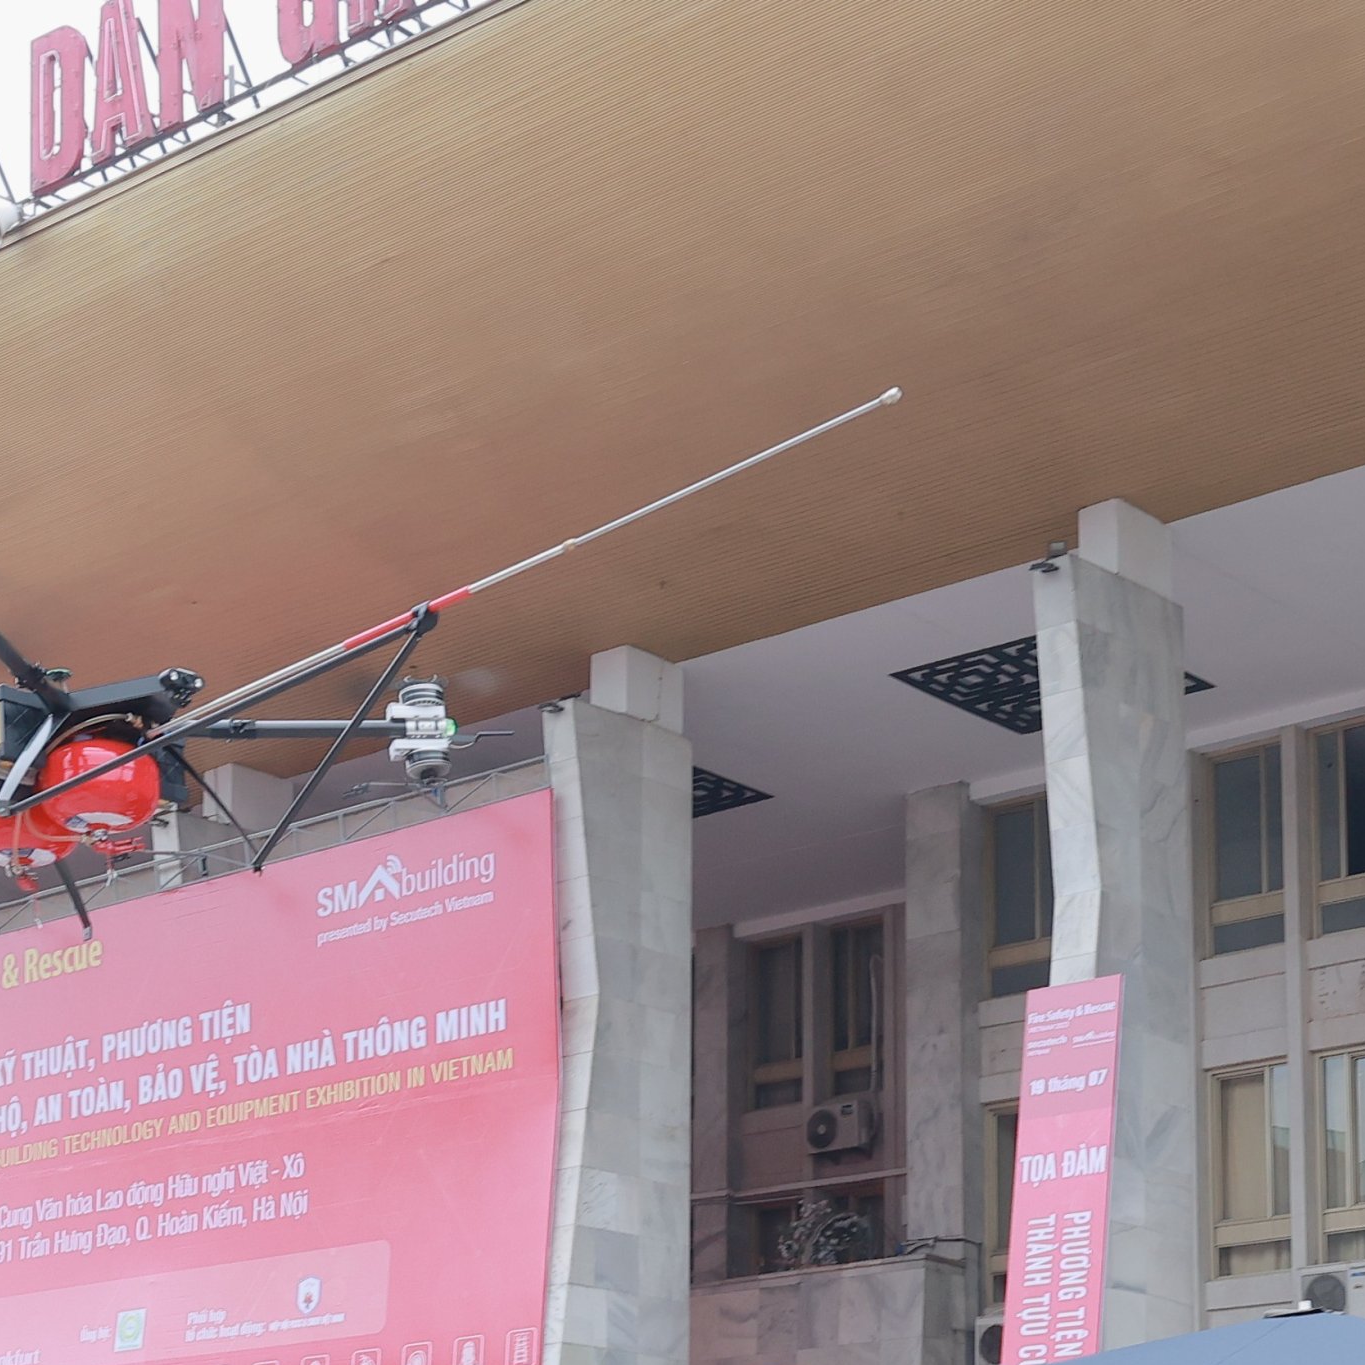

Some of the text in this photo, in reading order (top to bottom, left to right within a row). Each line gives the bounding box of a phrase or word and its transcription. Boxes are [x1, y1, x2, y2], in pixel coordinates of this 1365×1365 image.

[317, 889, 494, 947] presented by Secutech Vietnam
[1, 952, 20, 990] &
[24, 938, 104, 984] Rescue
[1075, 1004, 1084, 1017] &
[21, 1035, 96, 1081] THUẬT,
[101, 1014, 192, 1064] PHƯƠNG
[199, 999, 252, 1045] TIỆN
[34, 1091, 63, 1126] AN
[68, 1078, 131, 1116] TOÀN,
[138, 1064, 184, 1105] BẢO
[189, 1052, 227, 1098] VỆ,
[233, 1045, 280, 1087] TÒA
[286, 1029, 336, 1076] NHÀ
[342, 1016, 428, 1064] THÔNG
[435, 997, 508, 1045] MINH
[62, 1117, 164, 1155] TECHNOLOGY
[167, 1109, 201, 1135] AND
[206, 1090, 301, 1129] EQUIPMENT
[306, 1070, 401, 1110] EXHIBITION
[407, 1065, 426, 1090] IN
[431, 1047, 515, 1085] VIETNAM
[1048, 1075, 1086, 1093] tháng
[1088, 1068, 1109, 1087] 07
[35, 1196, 63, 1223] Văn
[65, 1191, 93, 1218] hóa
[96, 1187, 123, 1213] Lao
[126, 1179, 164, 1209] động
[238, 1159, 268, 1189] Việt
[282, 1153, 306, 1179] Xô
[1019, 1143, 1108, 1188] TỌA ĐÀM
[157, 1210, 198, 1238] Hoàn
[252, 1194, 277, 1221] Hà
[280, 1189, 309, 1219] Nội
[1023, 1212, 1057, 1288] THÀNH
[1055, 1211, 1092, 1357] PHƯƠNG TIỆN
[1020, 1293, 1050, 1337] TỰU
